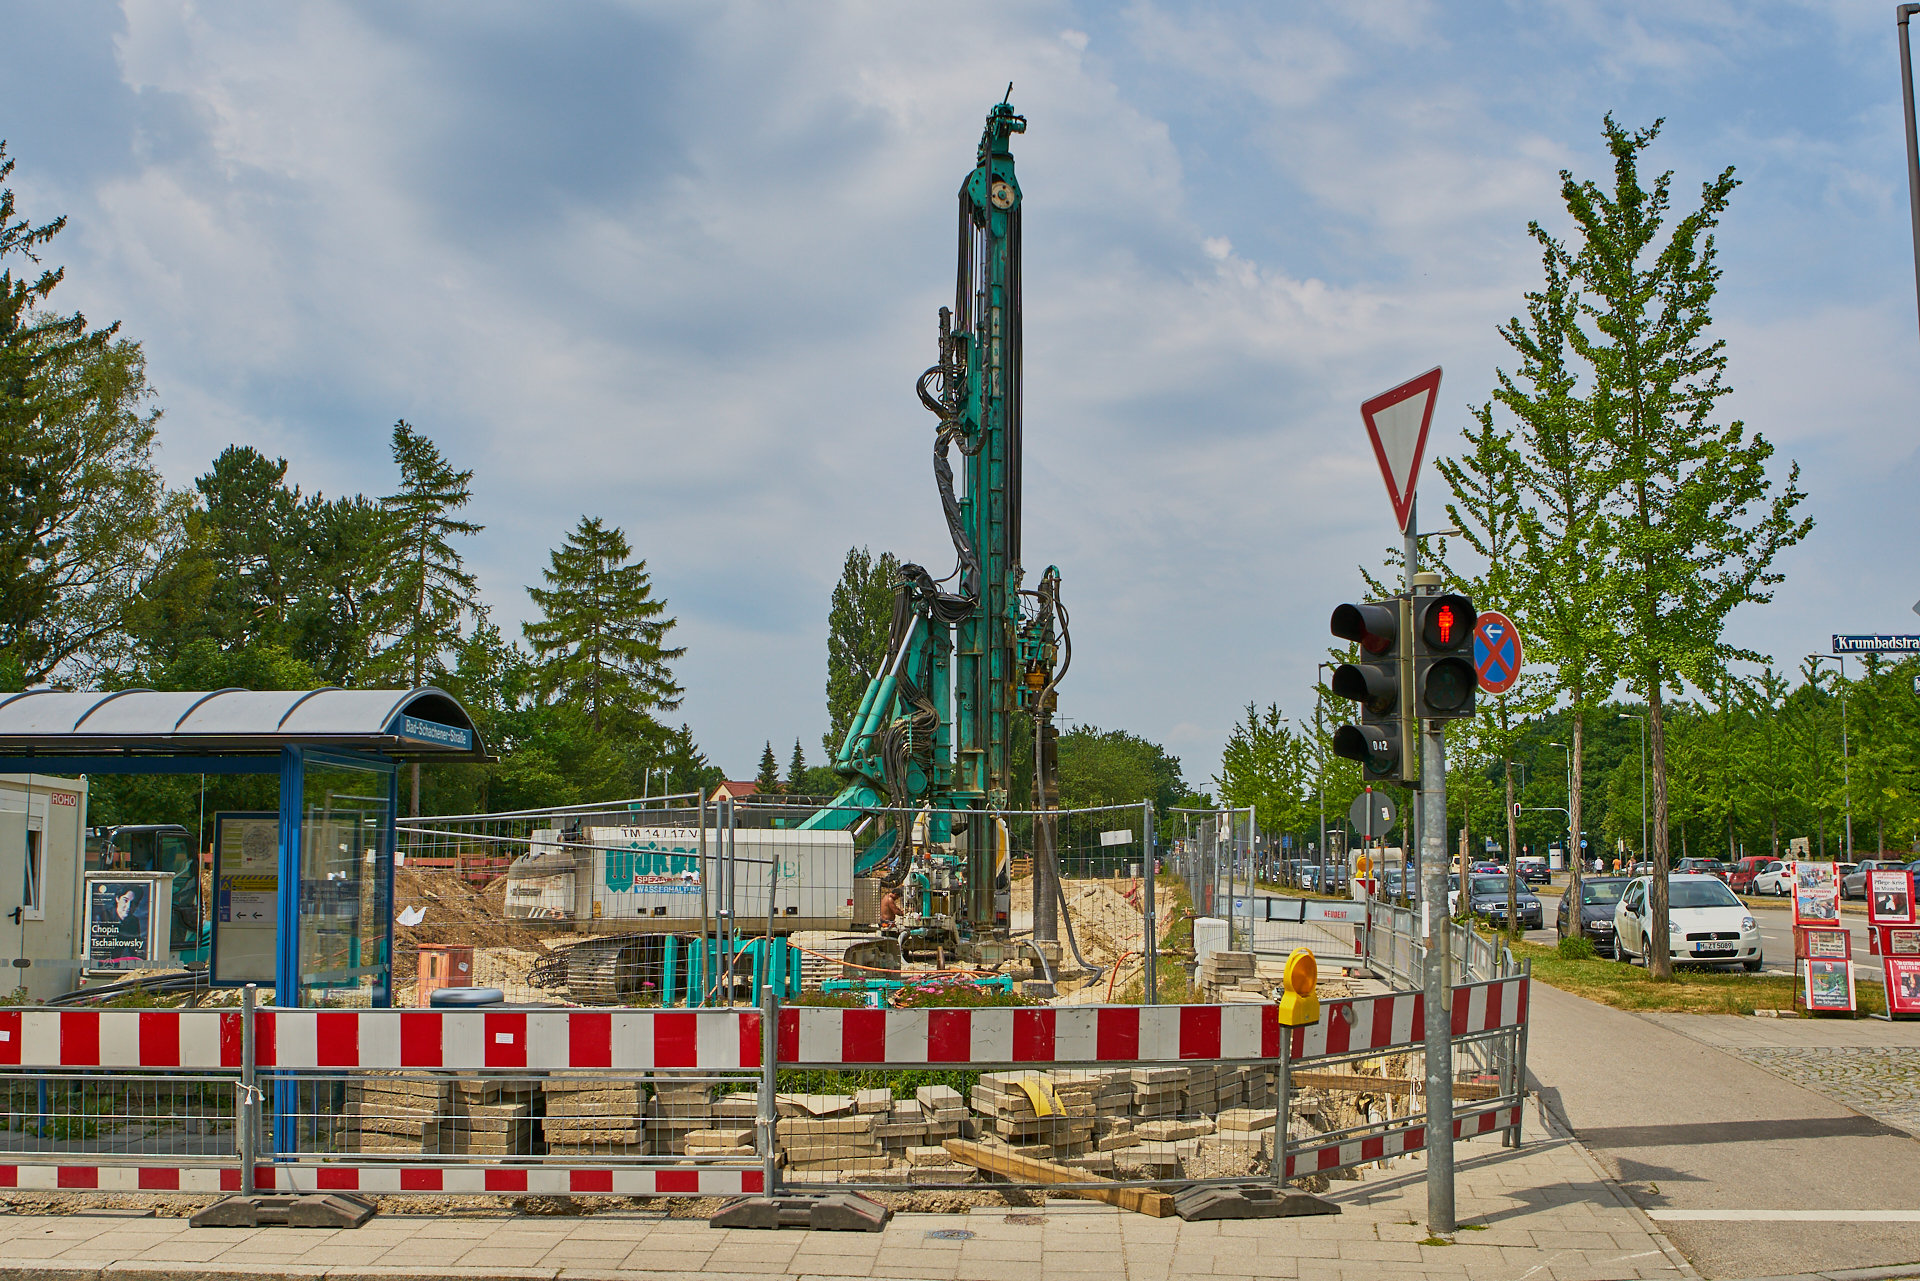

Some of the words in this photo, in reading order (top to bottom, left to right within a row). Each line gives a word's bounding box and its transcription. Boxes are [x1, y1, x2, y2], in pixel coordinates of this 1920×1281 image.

[1838, 636, 1920, 650] Krumbadstra
[405, 719, 467, 745] Bad-Schachener-Straße
[52, 793, 76, 806] ROHO
[91, 925, 120, 936] Chopin
[91, 938, 144, 950] Tschaikowsky
